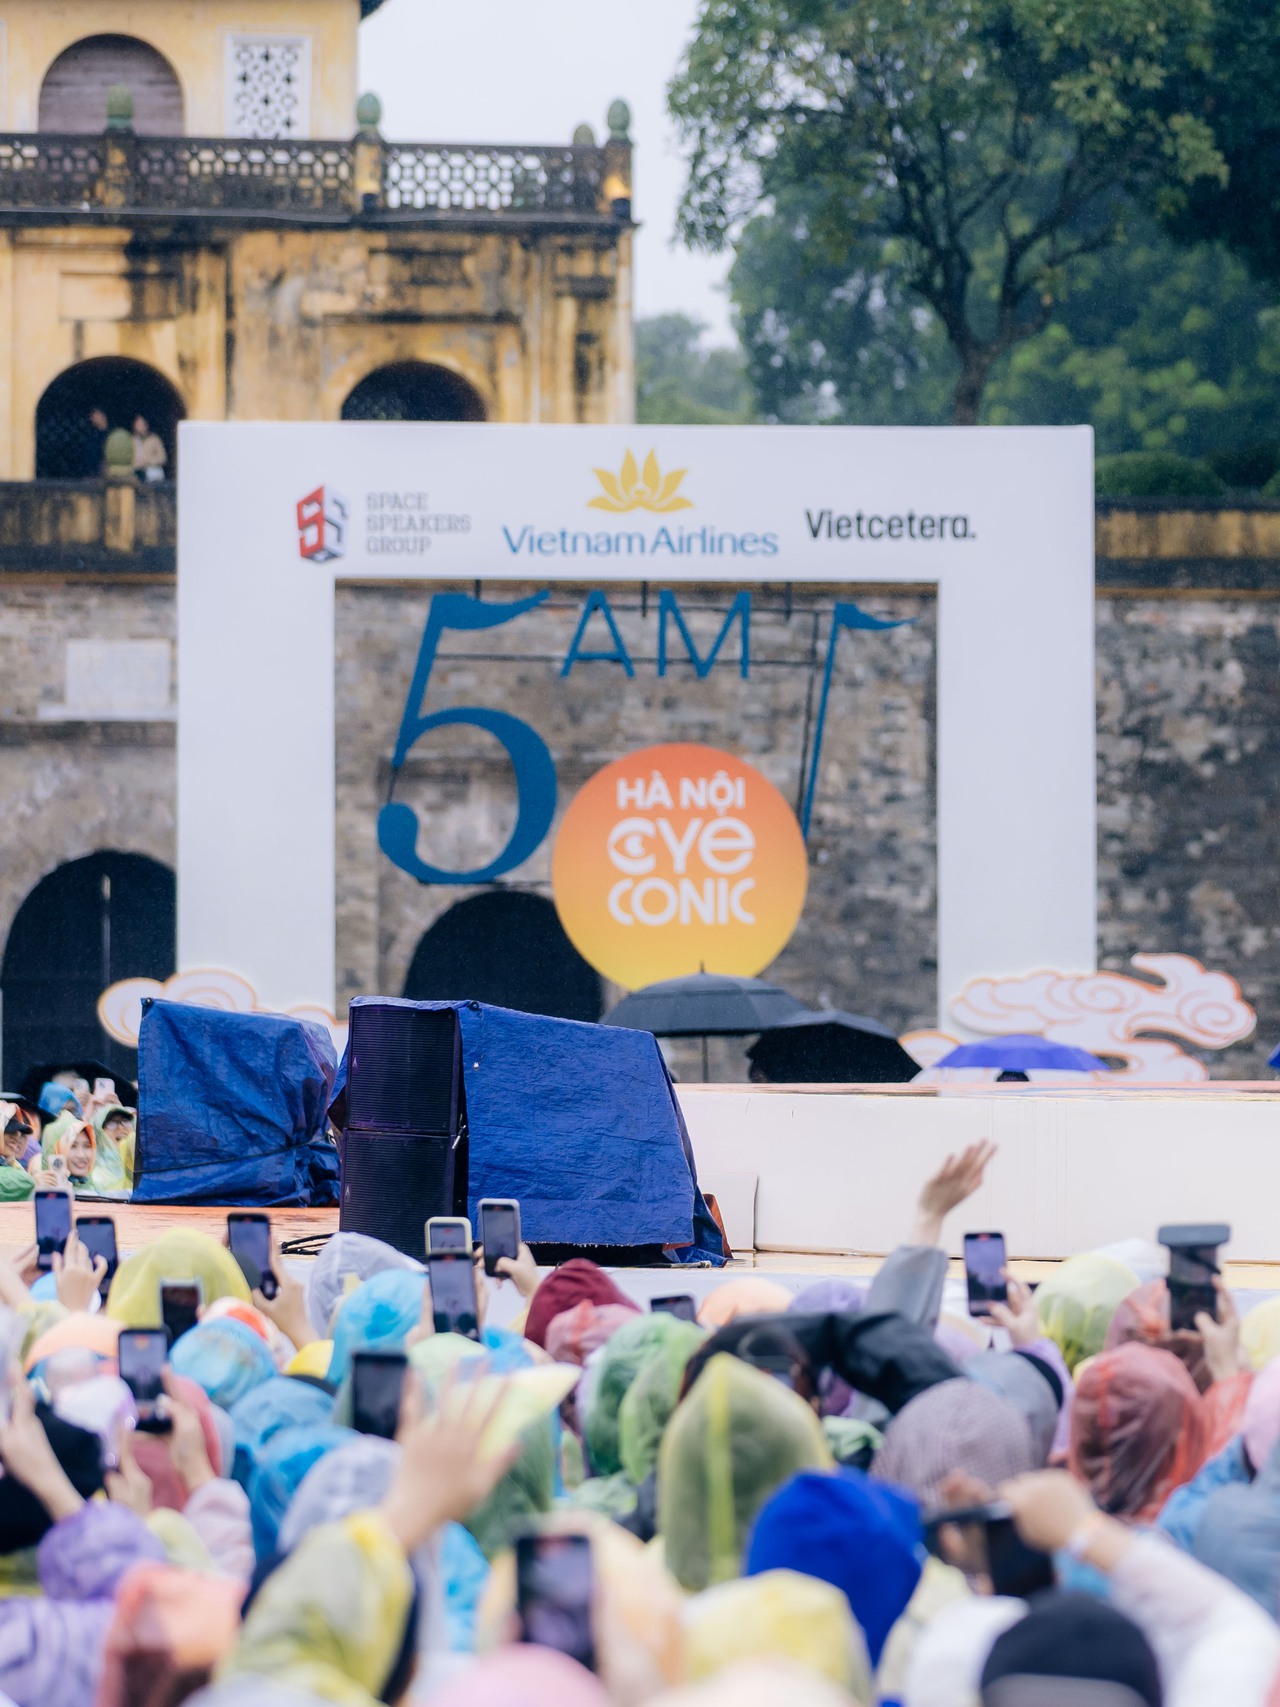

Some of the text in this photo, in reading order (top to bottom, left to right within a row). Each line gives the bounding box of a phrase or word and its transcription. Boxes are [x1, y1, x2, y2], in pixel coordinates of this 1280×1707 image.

[366, 492, 429, 511] SPACE
[366, 514, 472, 533] SPEAKERS
[805, 509, 977, 539] Vietcetera.
[366, 536, 432, 555] GROUP
[502, 525, 780, 556] Vietnam Airlines
[377, 589, 752, 885] 5 AM
[617, 770, 746, 816] HÀ NỘI
[607, 877, 756, 927] CONIC
